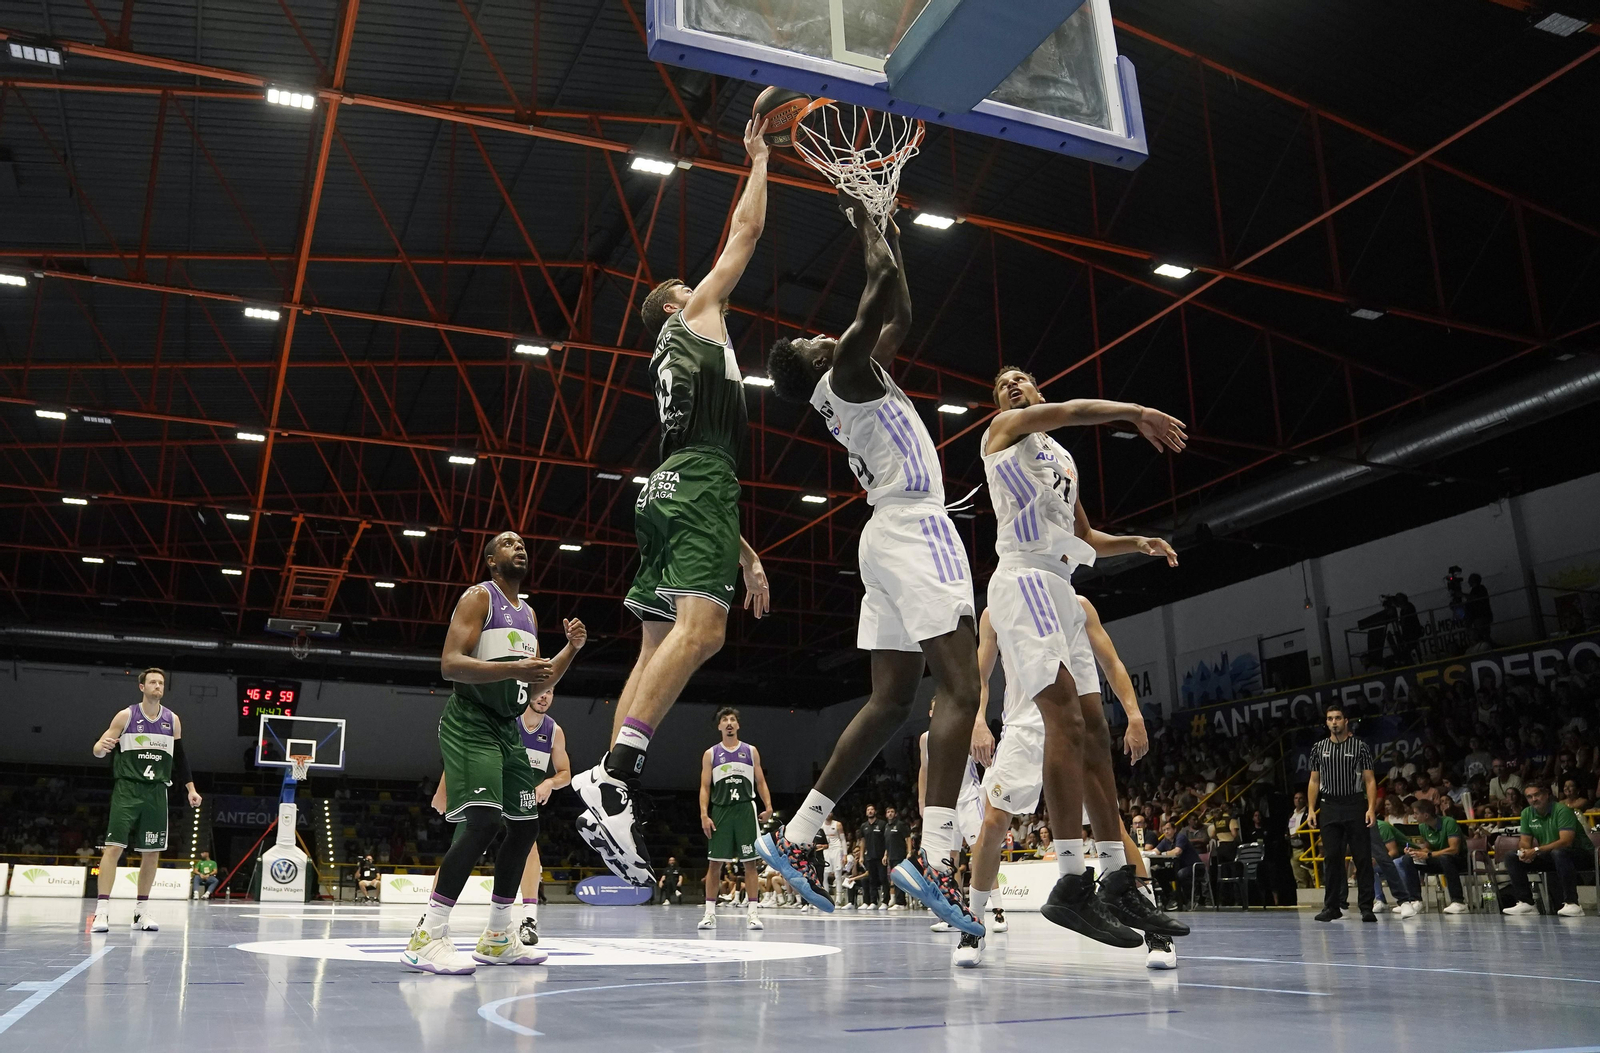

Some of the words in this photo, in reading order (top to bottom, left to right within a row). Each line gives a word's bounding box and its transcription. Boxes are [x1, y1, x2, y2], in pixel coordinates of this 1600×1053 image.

[657, 481, 677, 492] SOL
[247, 688, 260, 700] 46
[264, 690, 272, 700] 2
[280, 690, 294, 702] 59
[242, 706, 249, 716] 5
[143, 765, 155, 780] 4
[729, 788, 740, 801] 14
[1137, 829, 1143, 841] 5
[47, 877, 81, 886] Unicaja
[1002, 885, 1030, 898] Unicaja
